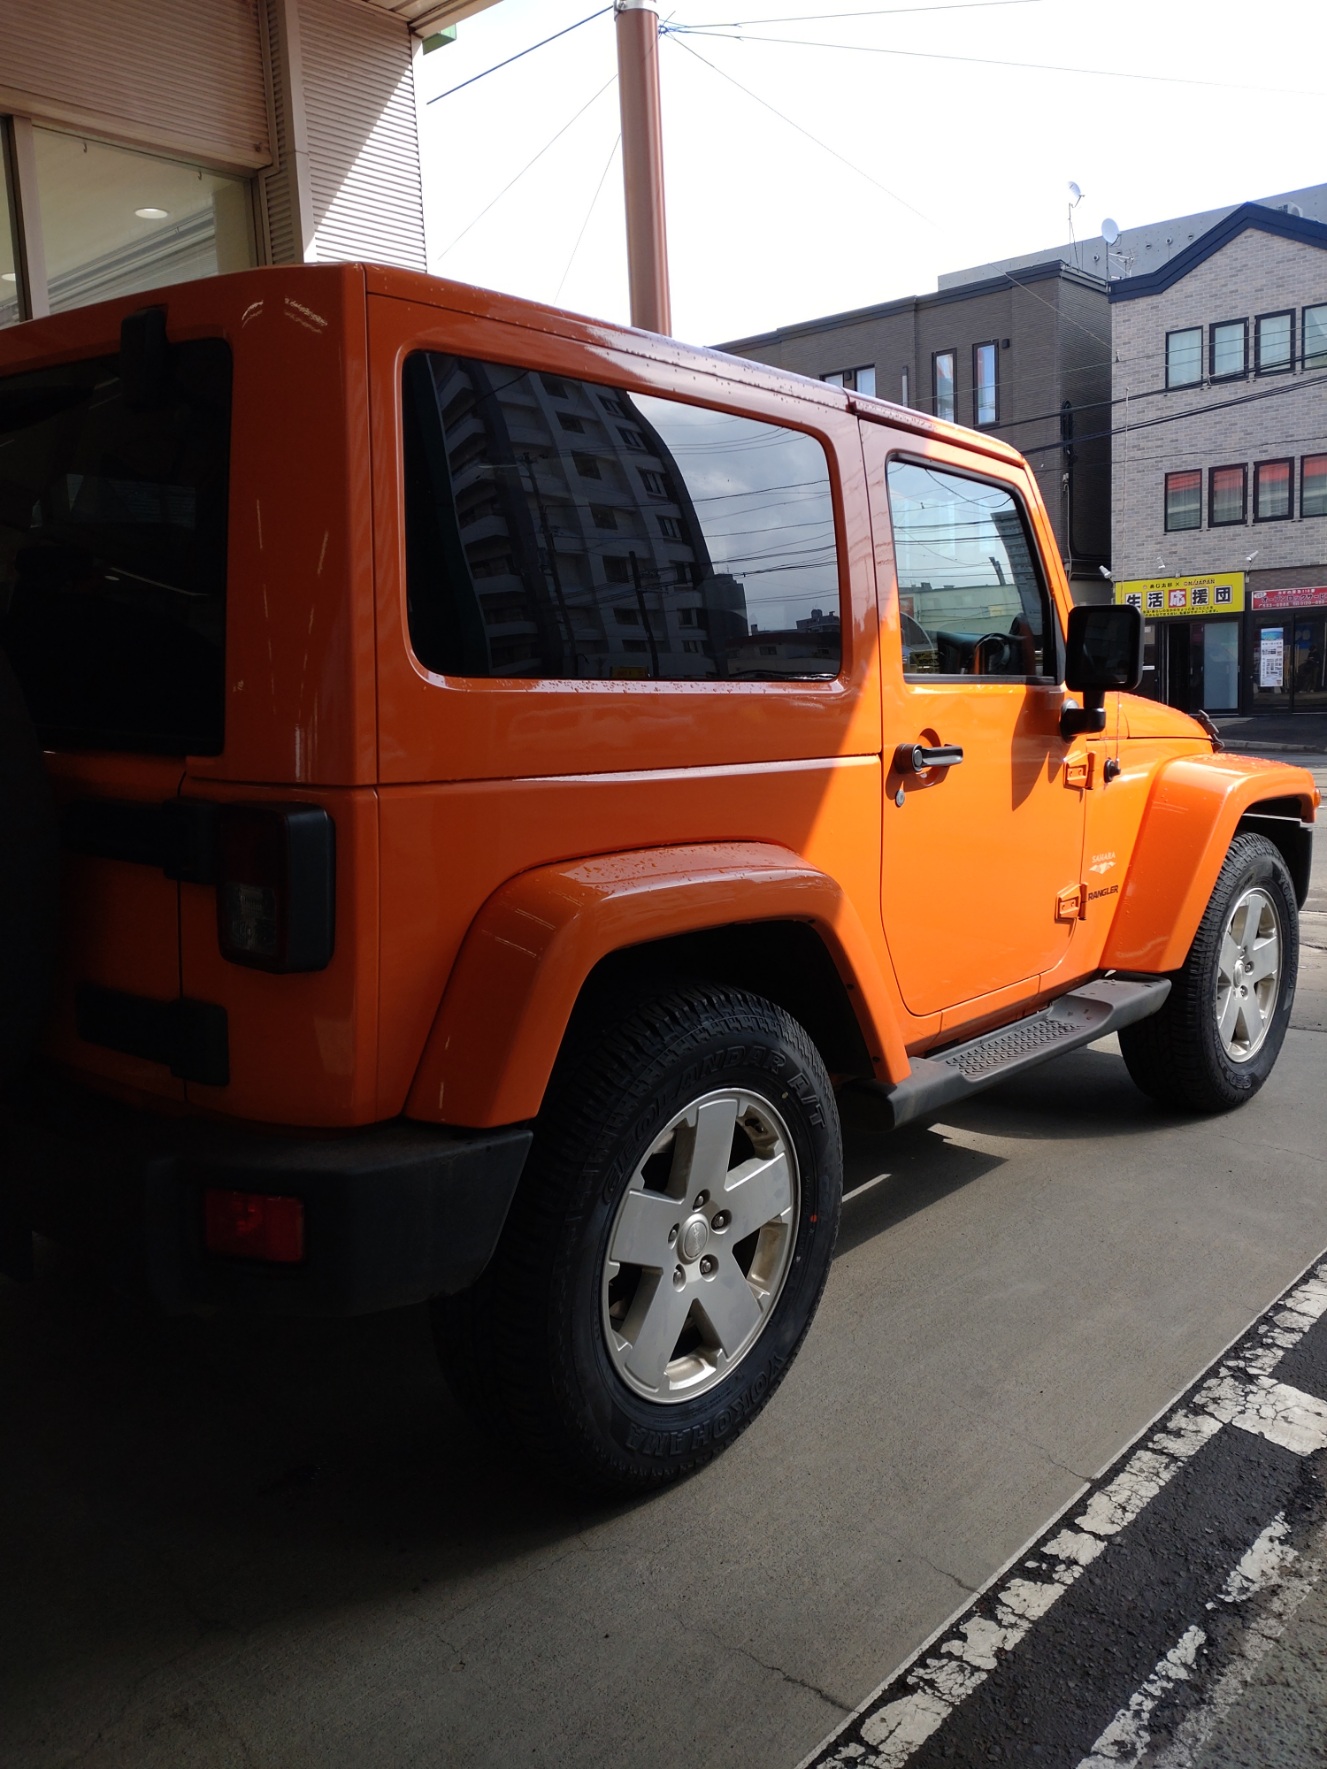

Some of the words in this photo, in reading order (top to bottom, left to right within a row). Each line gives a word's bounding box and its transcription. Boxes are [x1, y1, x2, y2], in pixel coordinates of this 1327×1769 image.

[1126, 586, 1232, 610] 生活応援団
[1087, 884, 1119, 902] RANGLER
